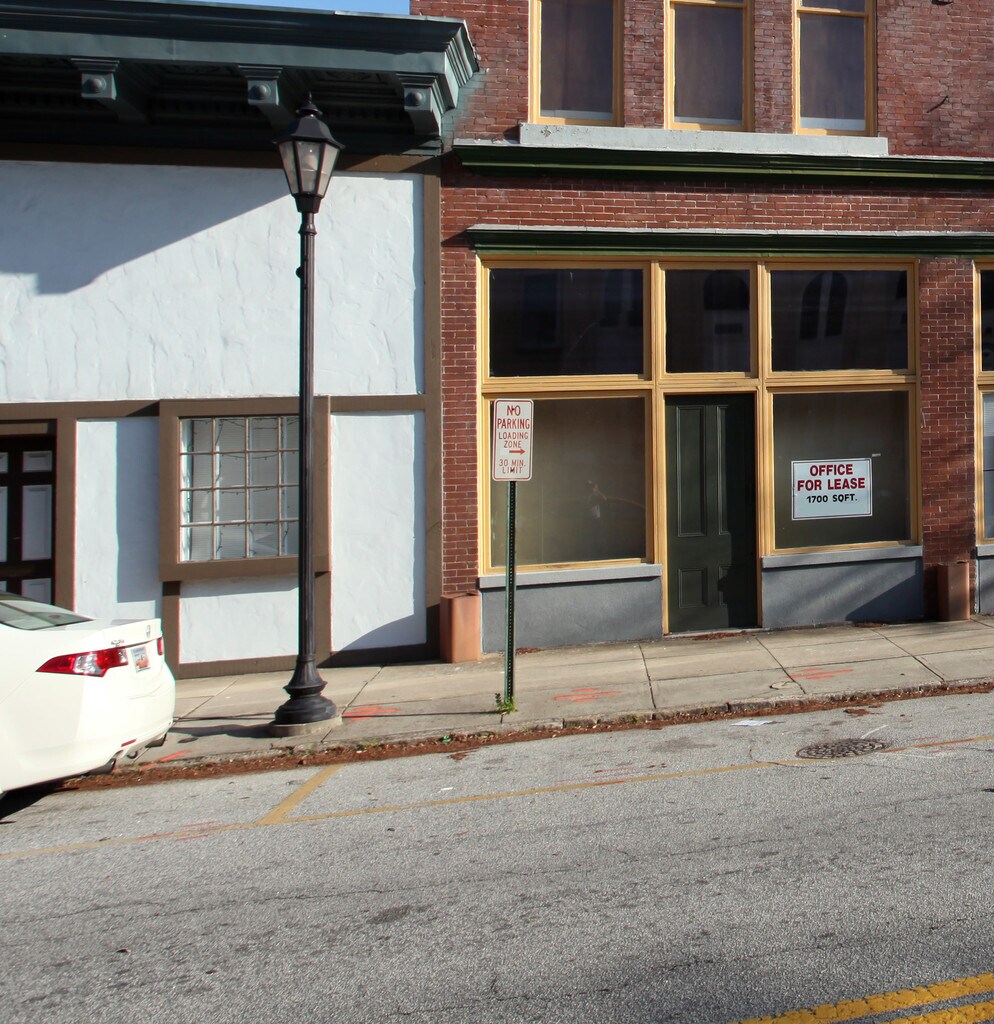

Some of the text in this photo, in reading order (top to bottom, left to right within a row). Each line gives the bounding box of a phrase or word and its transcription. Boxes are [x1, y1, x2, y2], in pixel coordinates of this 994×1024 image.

[507, 405, 521, 416] NO
[497, 418, 530, 429] PARKING
[498, 432, 529, 440] LOADING
[499, 459, 526, 467] 30 MIN.
[502, 466, 522, 474] LIMIT
[810, 464, 853, 476] OFFICE
[797, 477, 865, 491] FOR LEASE
[806, 495, 828, 503] 1700
